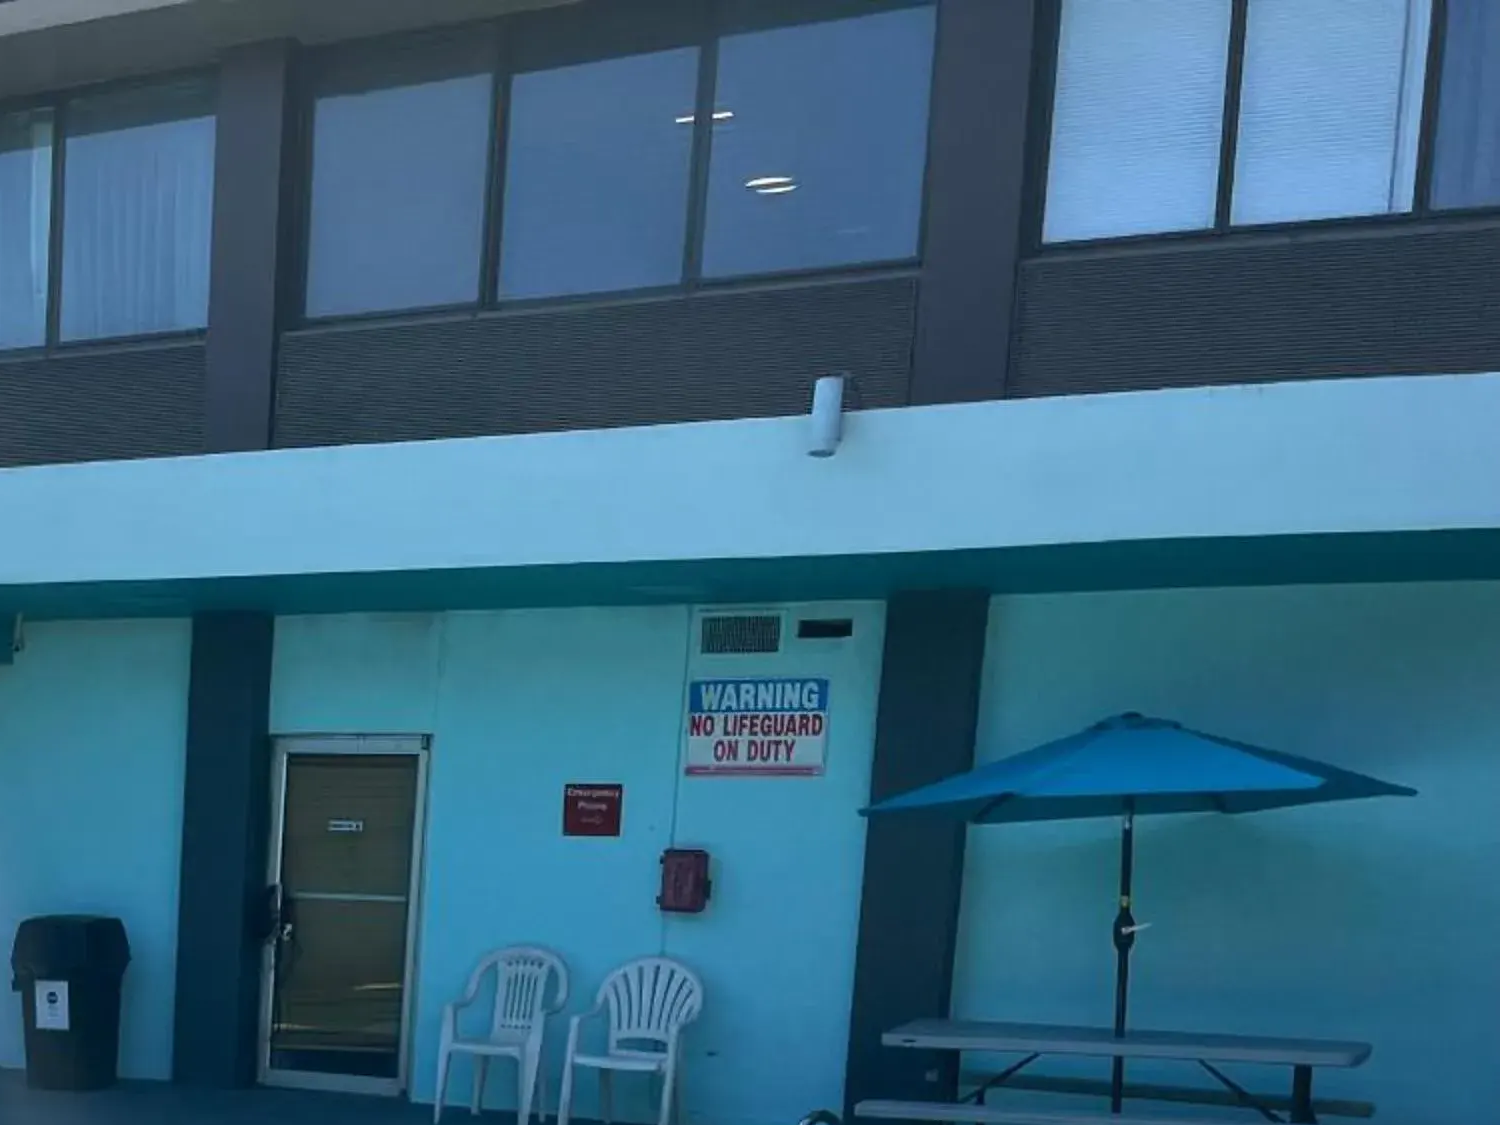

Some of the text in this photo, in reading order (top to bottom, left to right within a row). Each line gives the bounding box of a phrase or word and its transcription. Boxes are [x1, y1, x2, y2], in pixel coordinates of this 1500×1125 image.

[701, 681, 819, 711] WARNING
[690, 714, 823, 737] NO LIFEGUARD
[713, 739, 796, 762] ON DUTY
